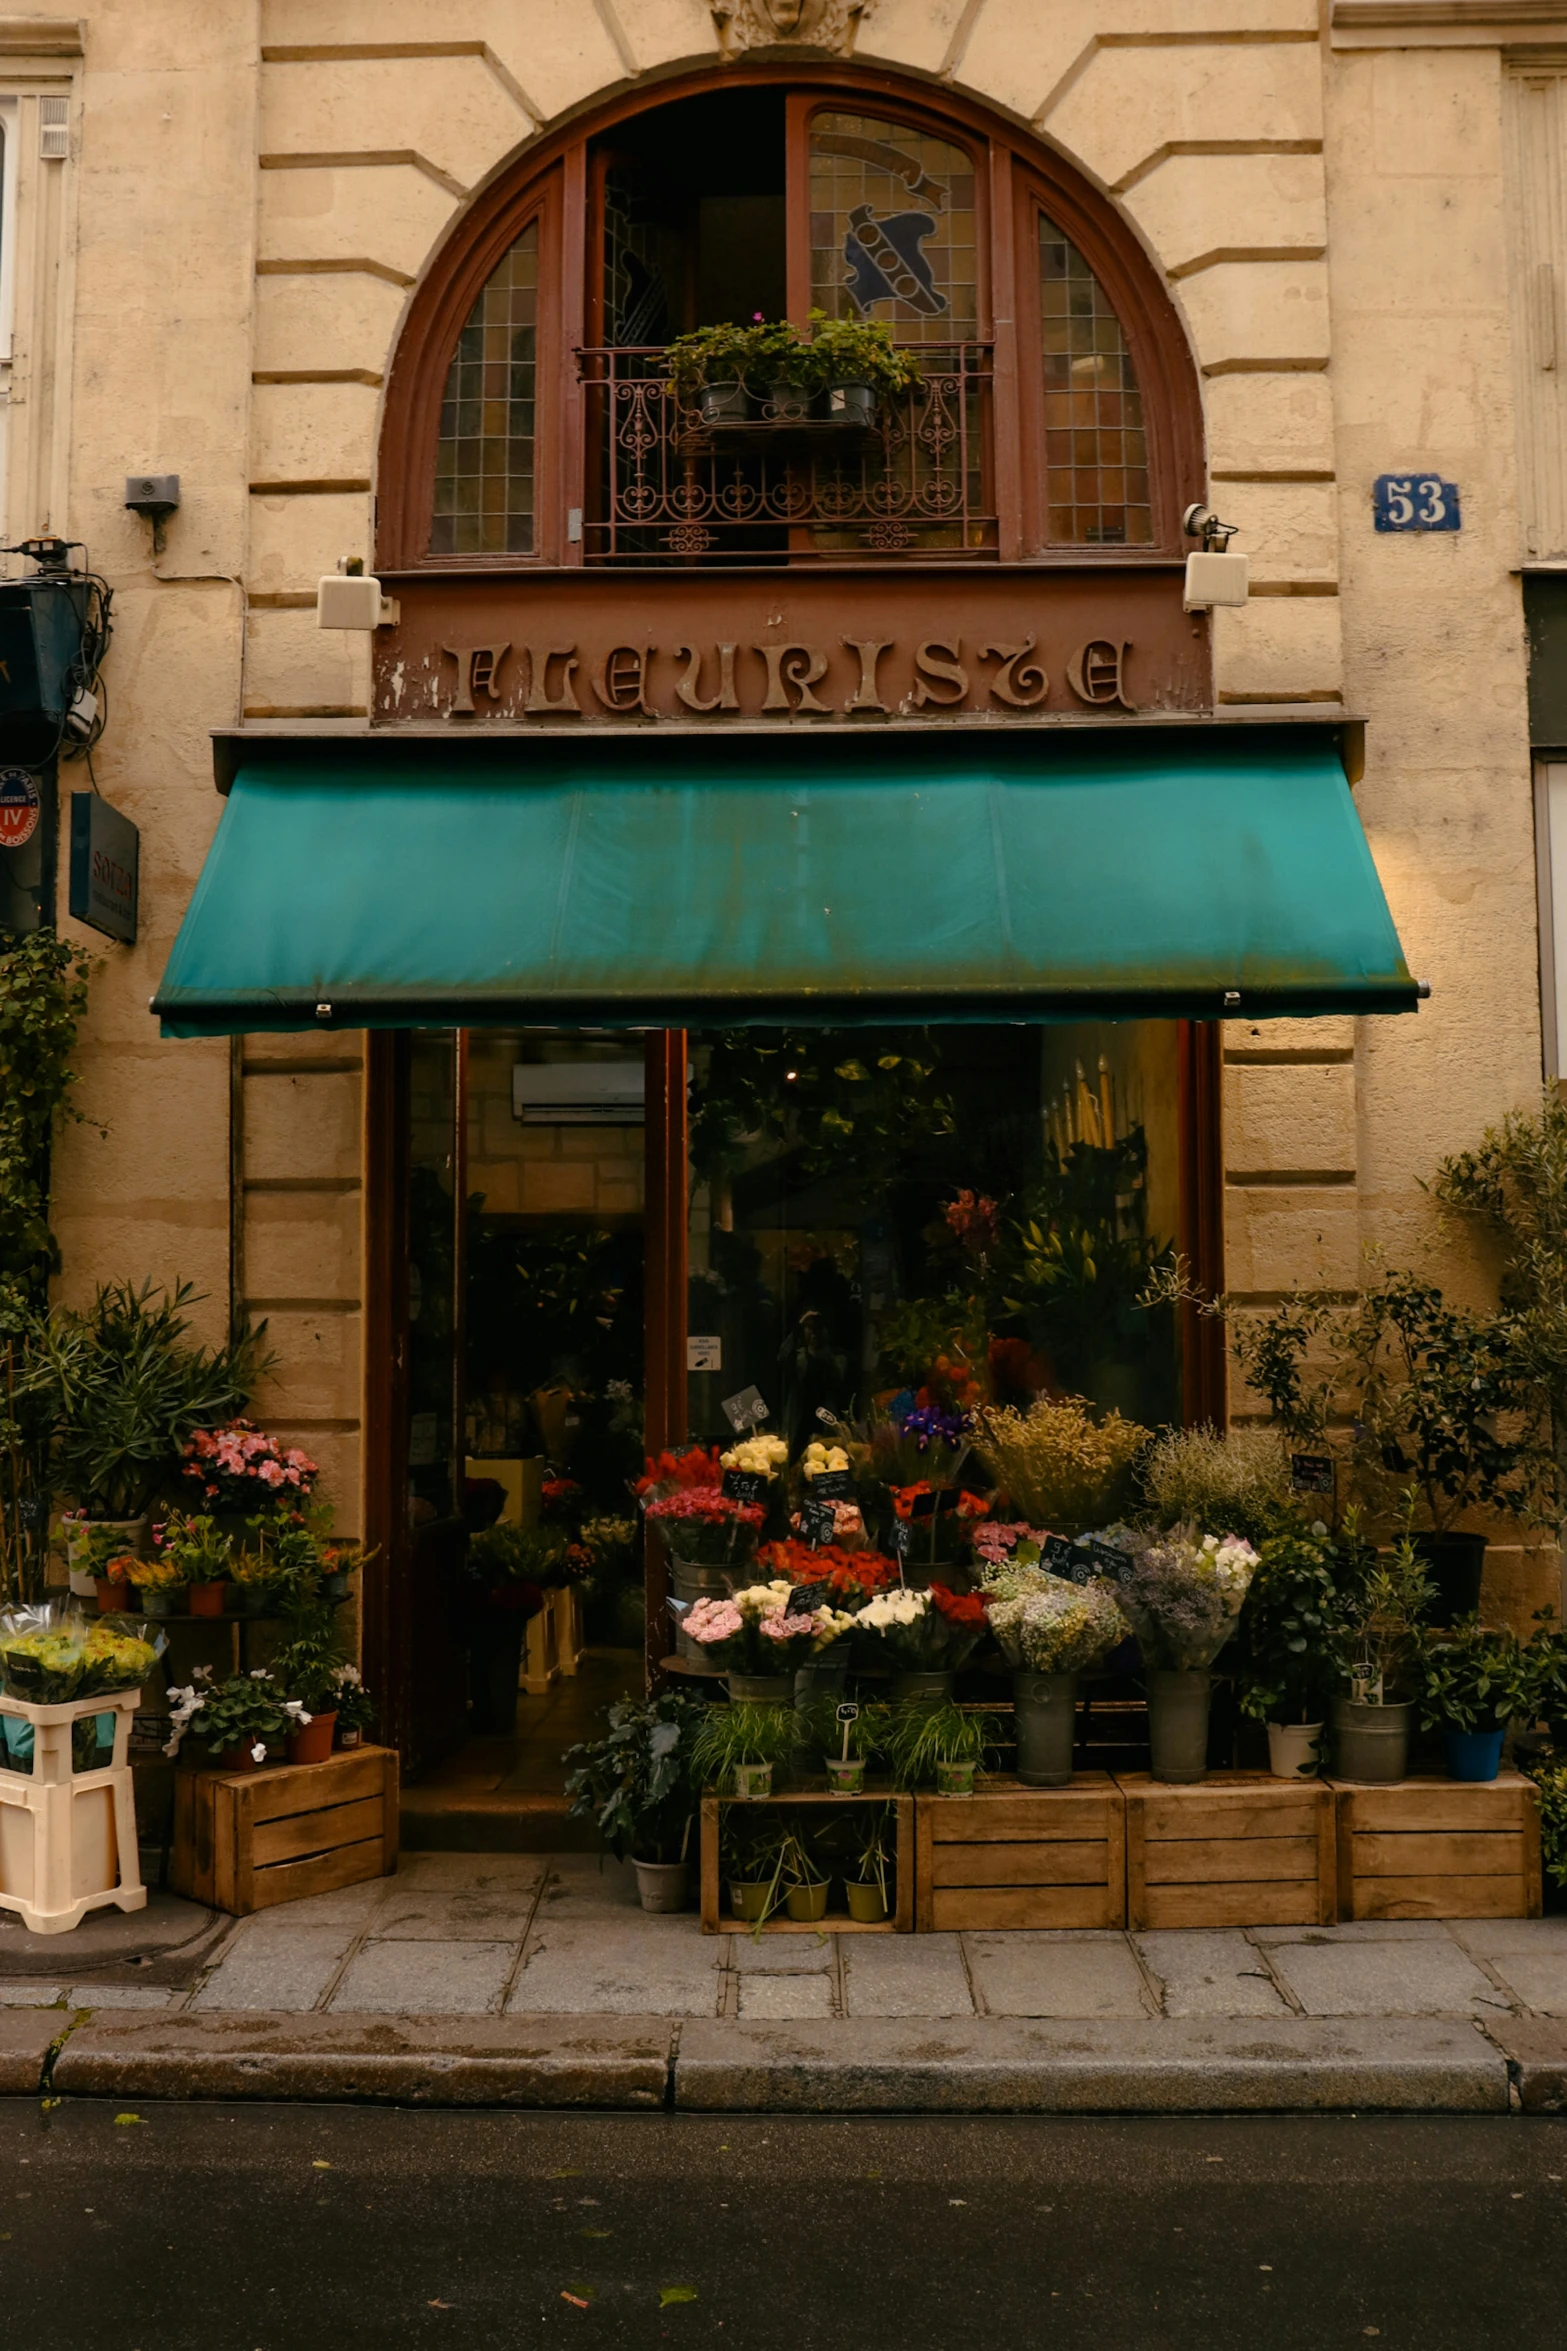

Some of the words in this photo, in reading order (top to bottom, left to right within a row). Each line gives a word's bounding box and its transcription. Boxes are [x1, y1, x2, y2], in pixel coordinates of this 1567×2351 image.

[1387, 480, 1446, 523] 53
[442, 632, 1137, 716] FLEURISTE
[3, 808, 23, 826] IV
